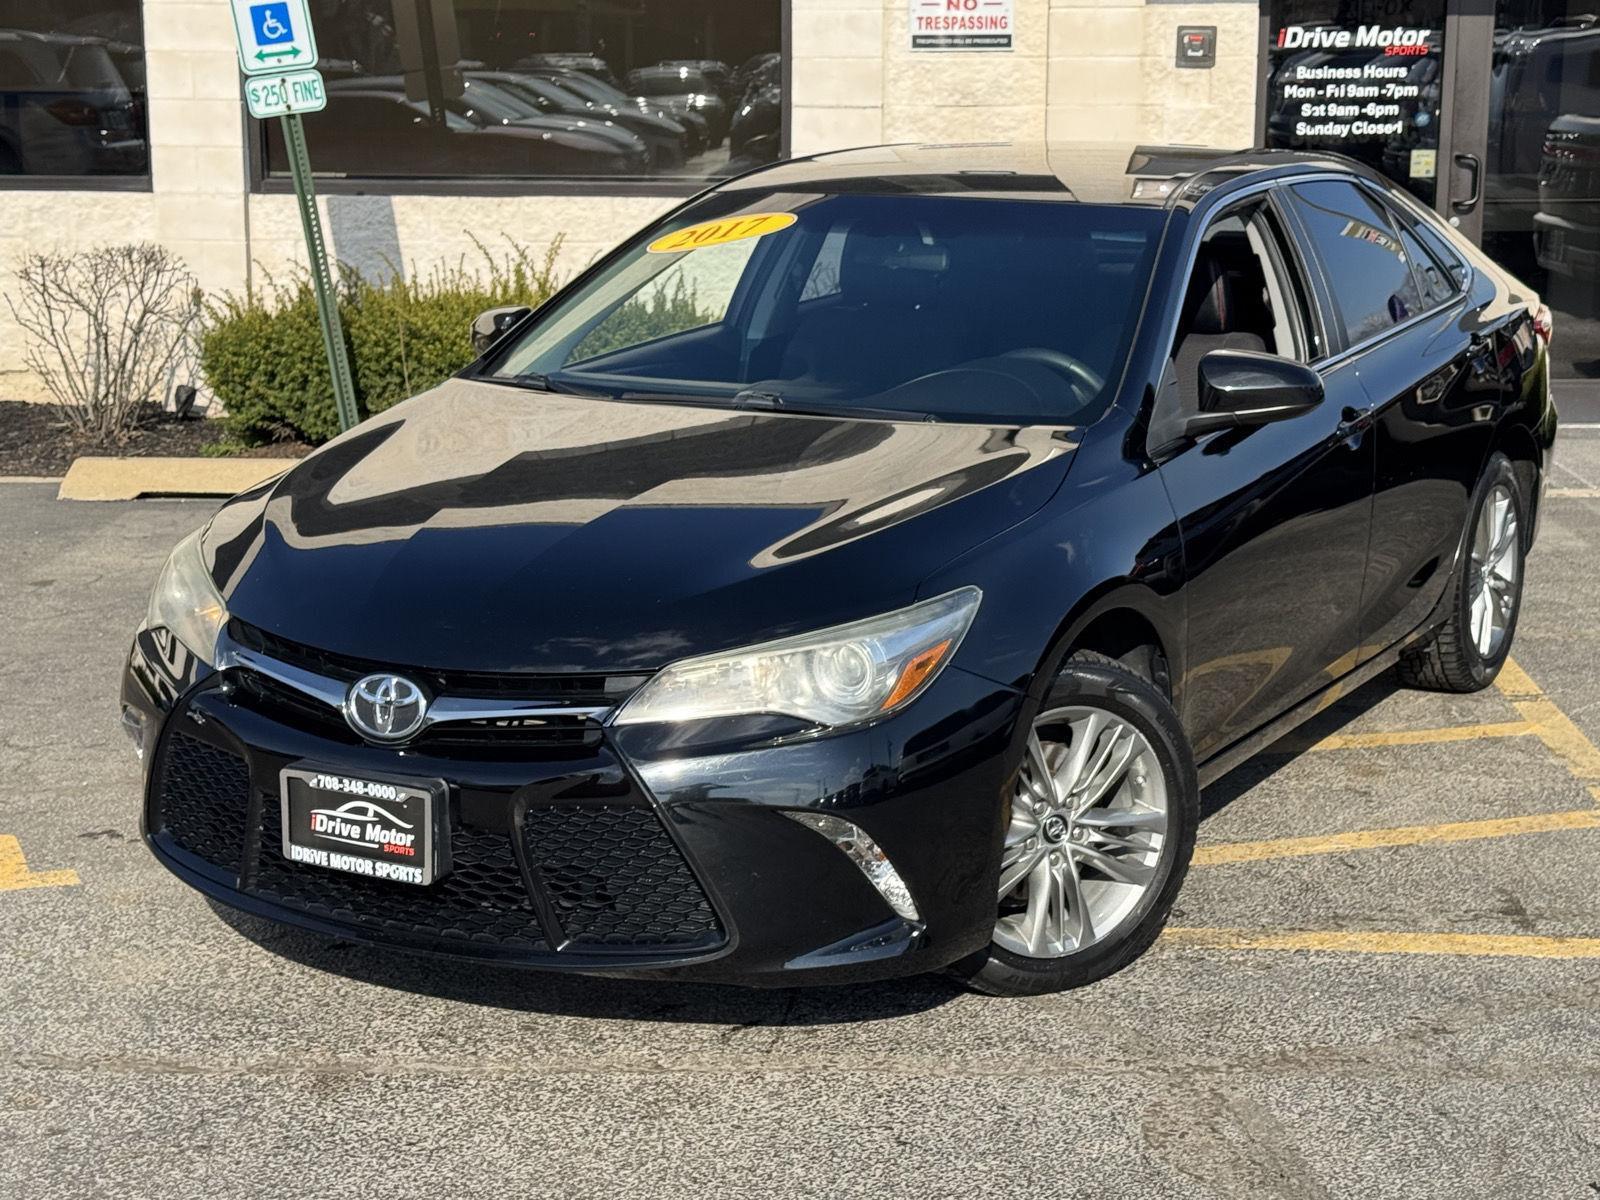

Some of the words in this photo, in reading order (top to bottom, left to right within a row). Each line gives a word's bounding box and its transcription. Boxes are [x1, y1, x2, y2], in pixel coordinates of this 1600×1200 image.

[946, 0, 977, 11] NO
[917, 16, 1008, 30] TRESPASSING
[1277, 26, 1350, 48] iDrive
[1355, 25, 1431, 47] Motor
[1384, 45, 1430, 56] SPORTS
[1296, 65, 1361, 79] Business
[1363, 65, 1408, 79] Hours
[292, 80, 322, 102] FINE
[1284, 85, 1315, 99] Mon
[1326, 84, 1345, 98] Fri
[1347, 84, 1379, 98] 9am
[1301, 103, 1326, 117] Sat
[1327, 103, 1359, 116] 9am
[1296, 122, 1350, 137] Sunday
[1351, 121, 1403, 135] Closed
[666, 216, 773, 249] 2017
[317, 775, 396, 800] 708-348-0000
[310, 814, 361, 838] iDrive
[365, 823, 415, 847] Motor
[383, 845, 415, 857] SPORTS
[330, 853, 373, 875] MOTOR
[375, 861, 423, 883] SPORTS
